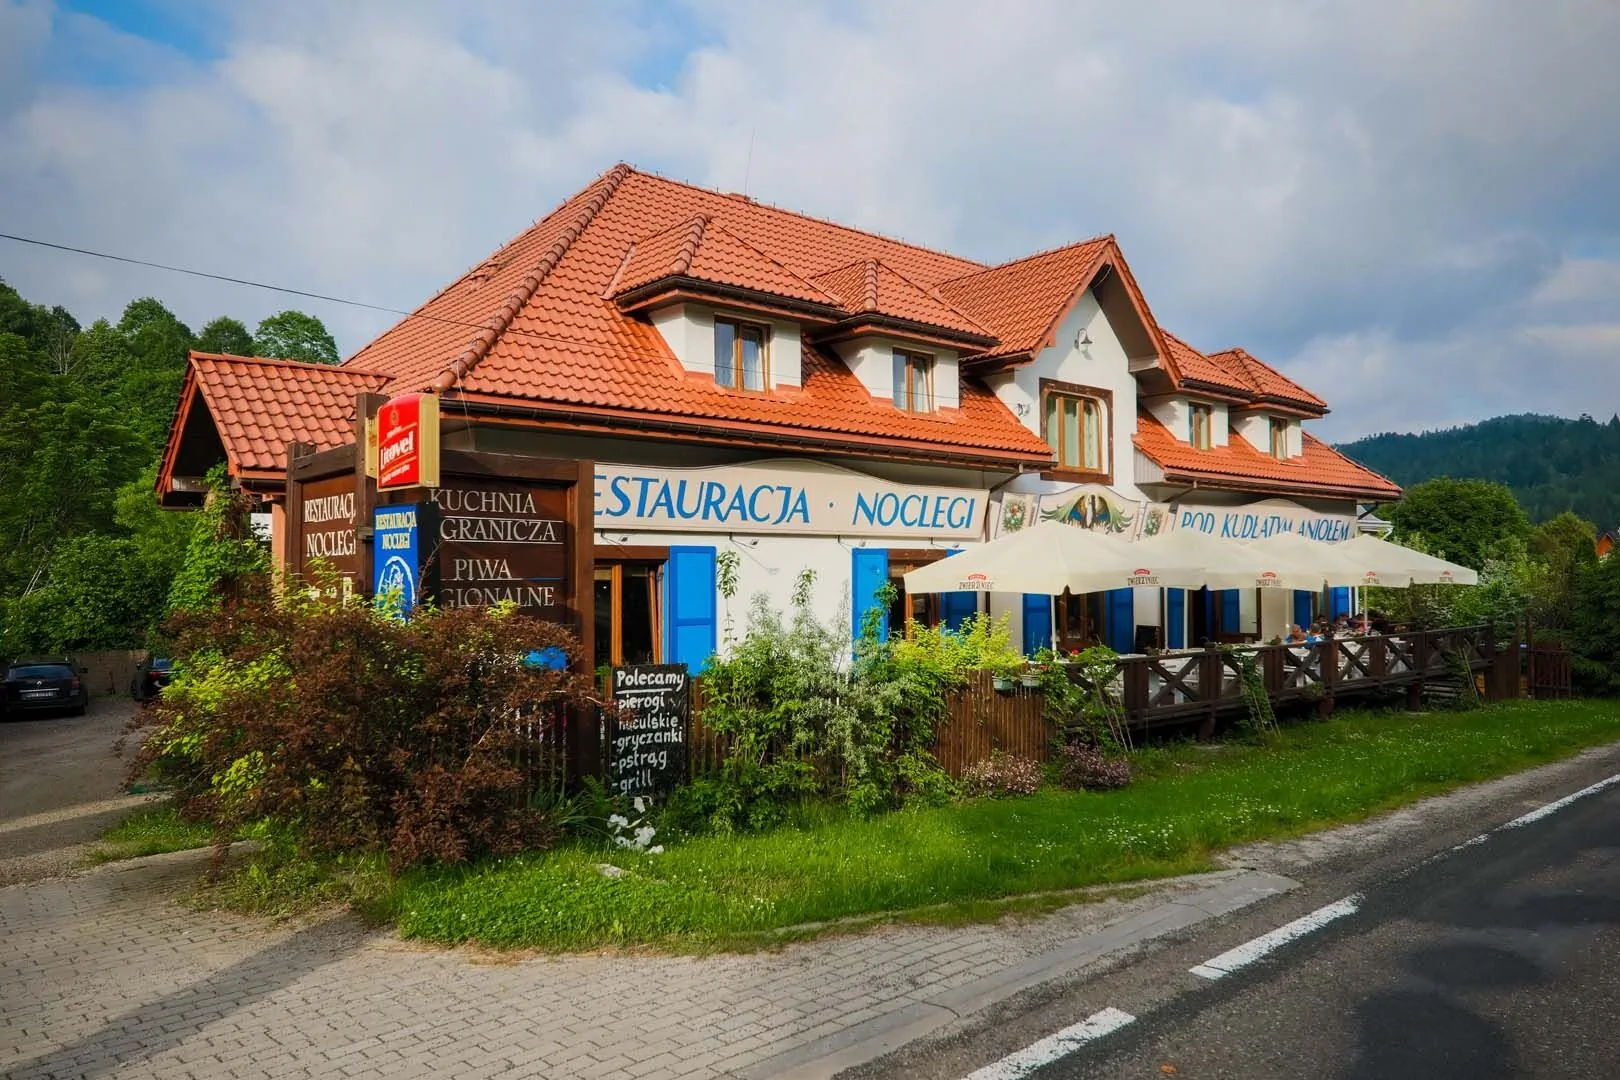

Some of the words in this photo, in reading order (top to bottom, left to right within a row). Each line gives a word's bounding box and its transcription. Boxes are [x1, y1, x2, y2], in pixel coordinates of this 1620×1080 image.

[304, 493, 356, 524] RESTAURACJ
[427, 488, 536, 514] KUCHNIA
[593, 475, 810, 525] ESTAURACJA
[852, 492, 976, 528] NOCLEGI
[375, 511, 417, 532] RESTAURACJA
[440, 518, 556, 541] GRANICZA
[1181, 511, 1216, 535] POD
[382, 532, 411, 549] NOCLEGI
[454, 558, 513, 581] PIWA
[440, 586, 556, 608] GIONALNE
[616, 668, 685, 692] Polecamy
[618, 691, 665, 714] pierogi
[612, 726, 683, 752] -gryczanki
[611, 768, 653, 795] -grill
